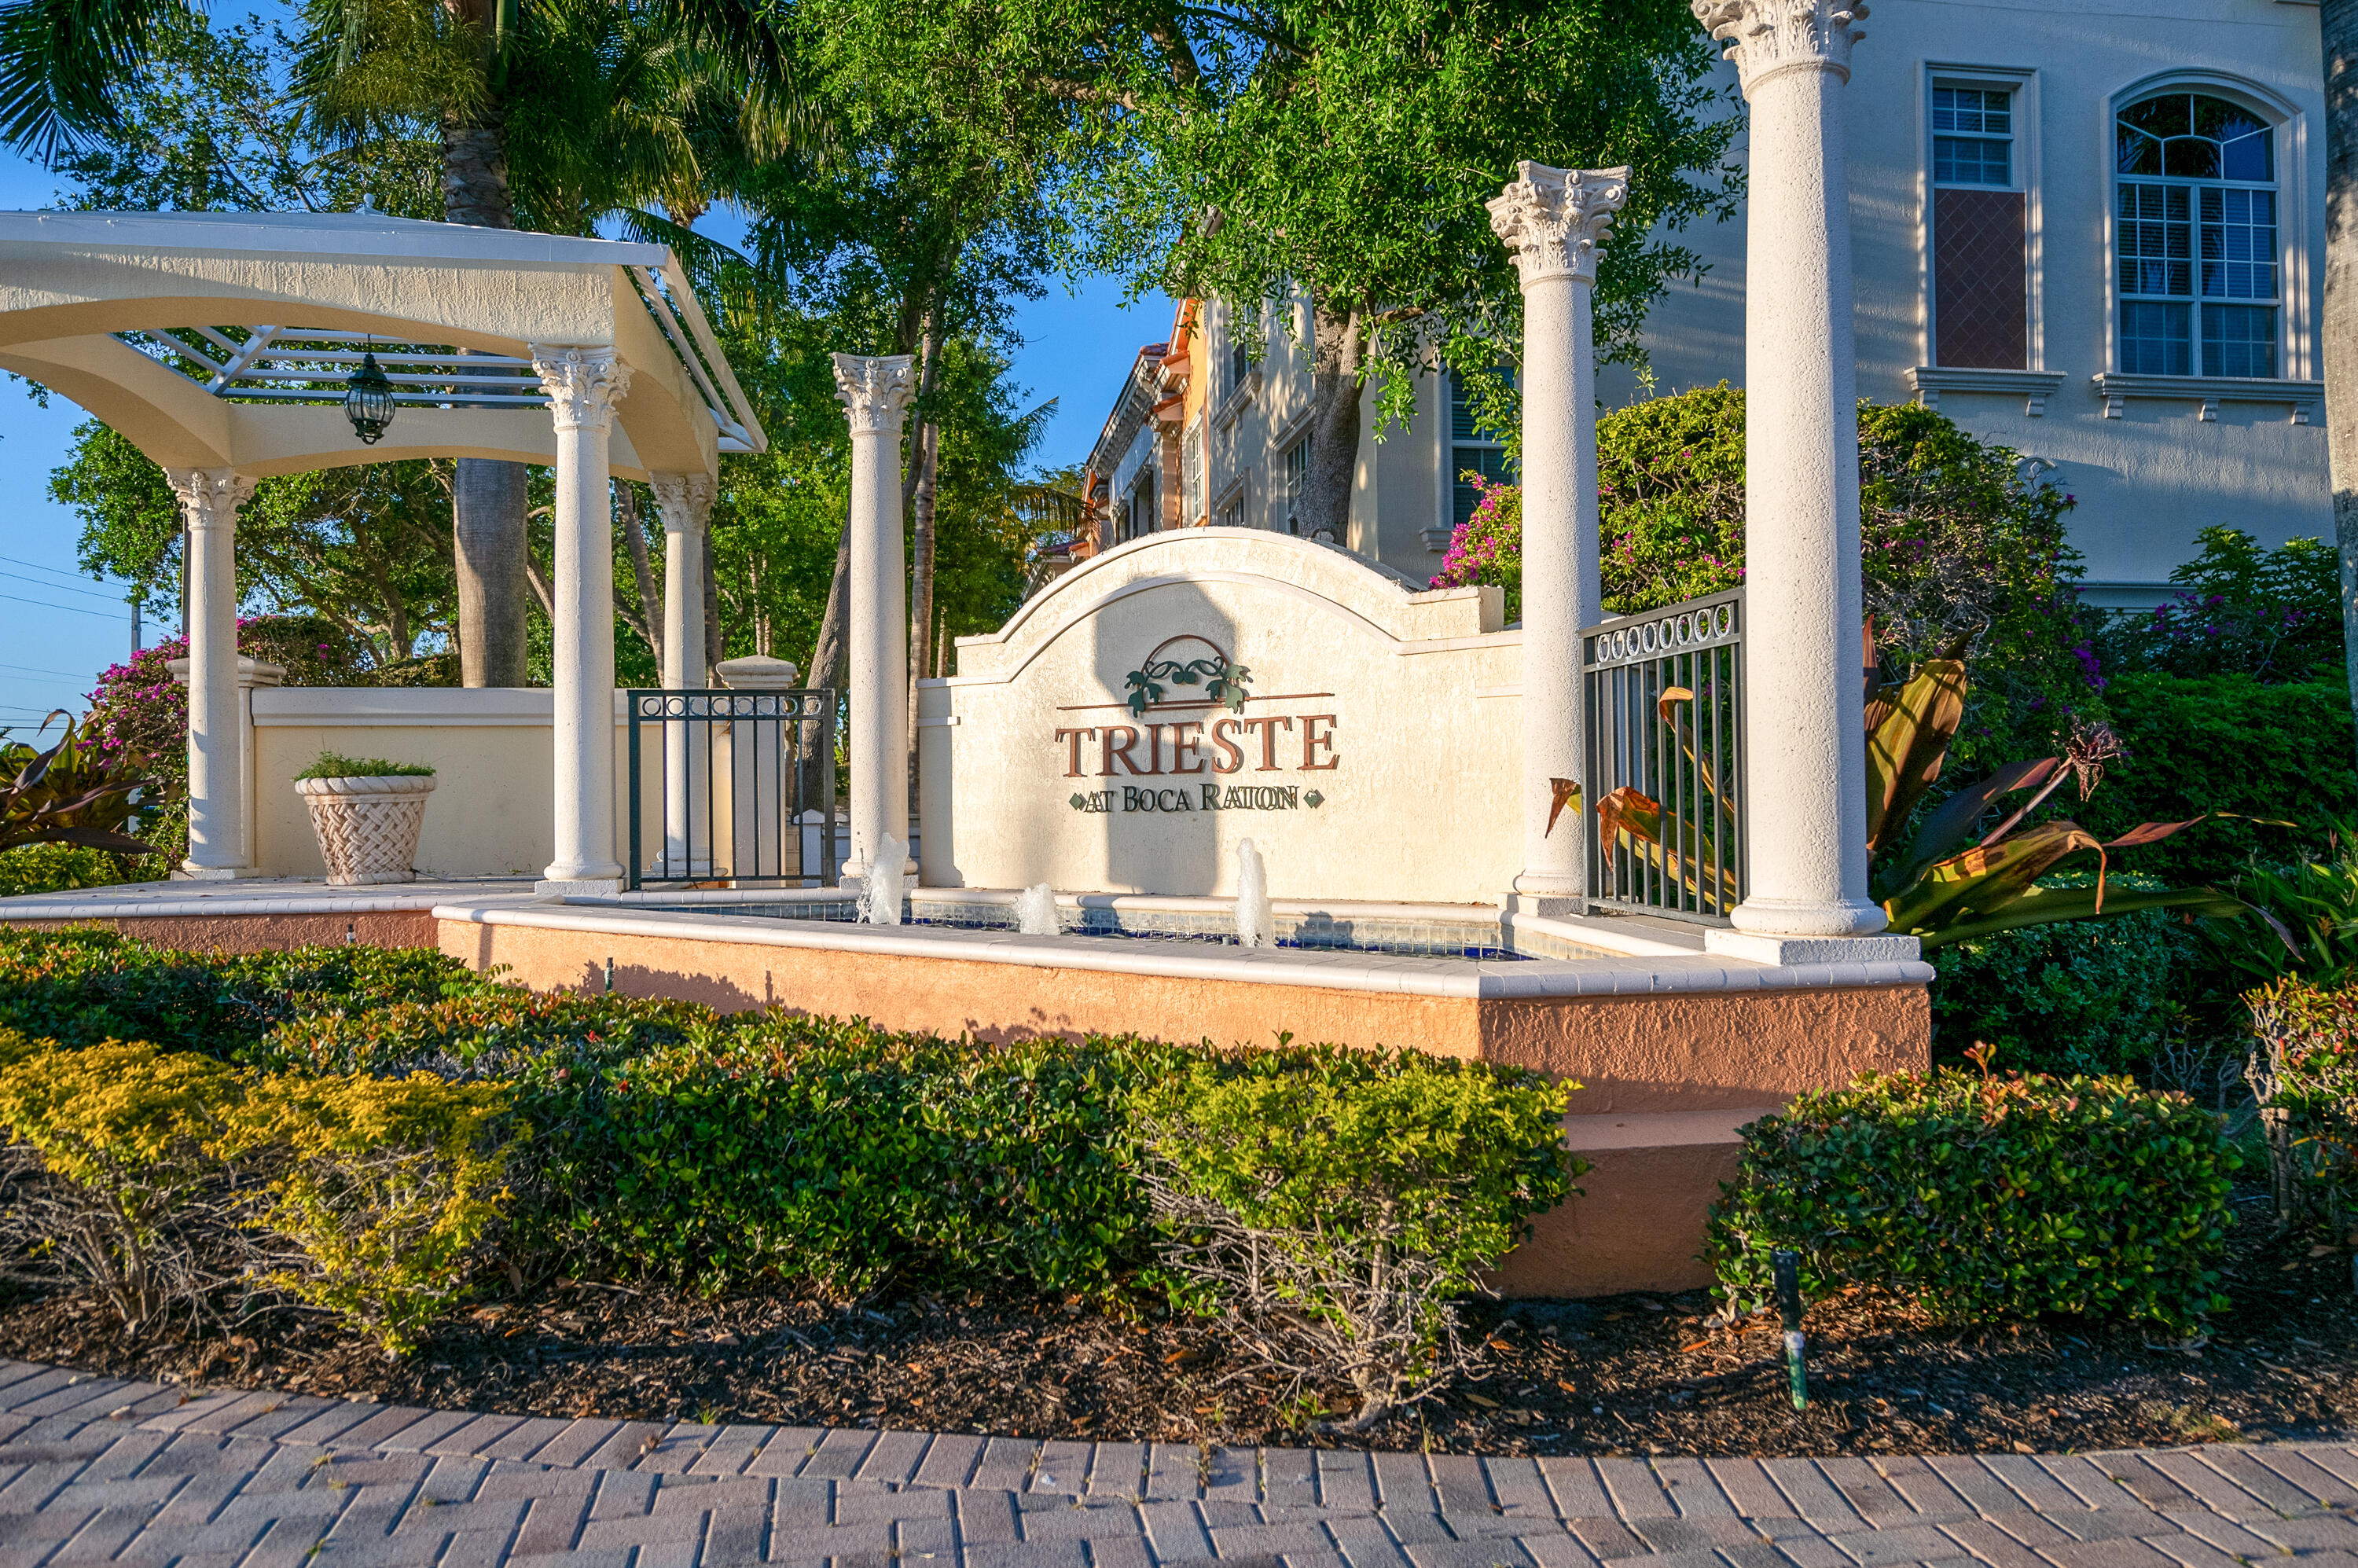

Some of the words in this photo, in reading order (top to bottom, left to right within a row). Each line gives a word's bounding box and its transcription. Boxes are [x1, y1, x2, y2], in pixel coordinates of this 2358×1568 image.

[1054, 714, 1339, 778] TRIESTE
[1083, 789, 1115, 813] AT
[1121, 785, 1192, 813] BOCA
[1199, 783, 1300, 811] RATON
